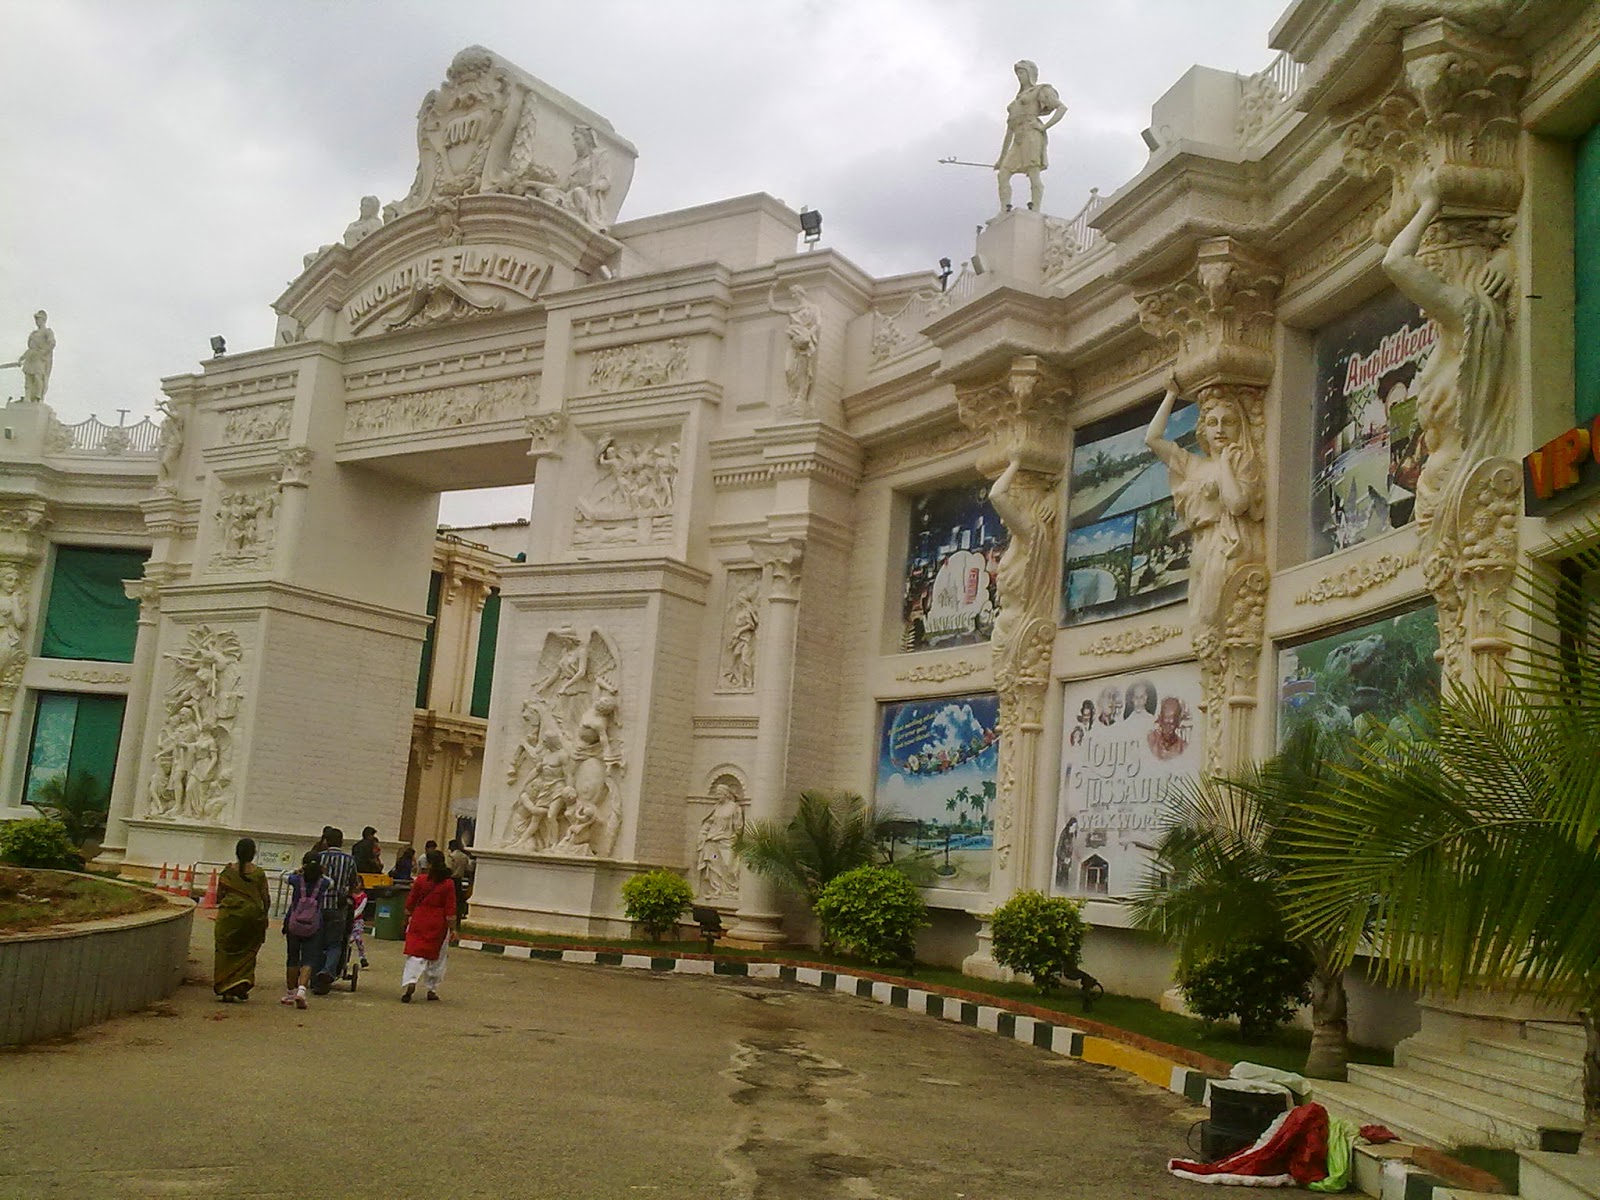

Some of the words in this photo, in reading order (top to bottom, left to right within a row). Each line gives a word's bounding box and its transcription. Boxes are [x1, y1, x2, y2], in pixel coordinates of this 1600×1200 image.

[444, 118, 480, 149] 2007
[349, 257, 443, 325] INNOVATIVE
[450, 250, 497, 278] FILM
[494, 255, 541, 291] CITY
